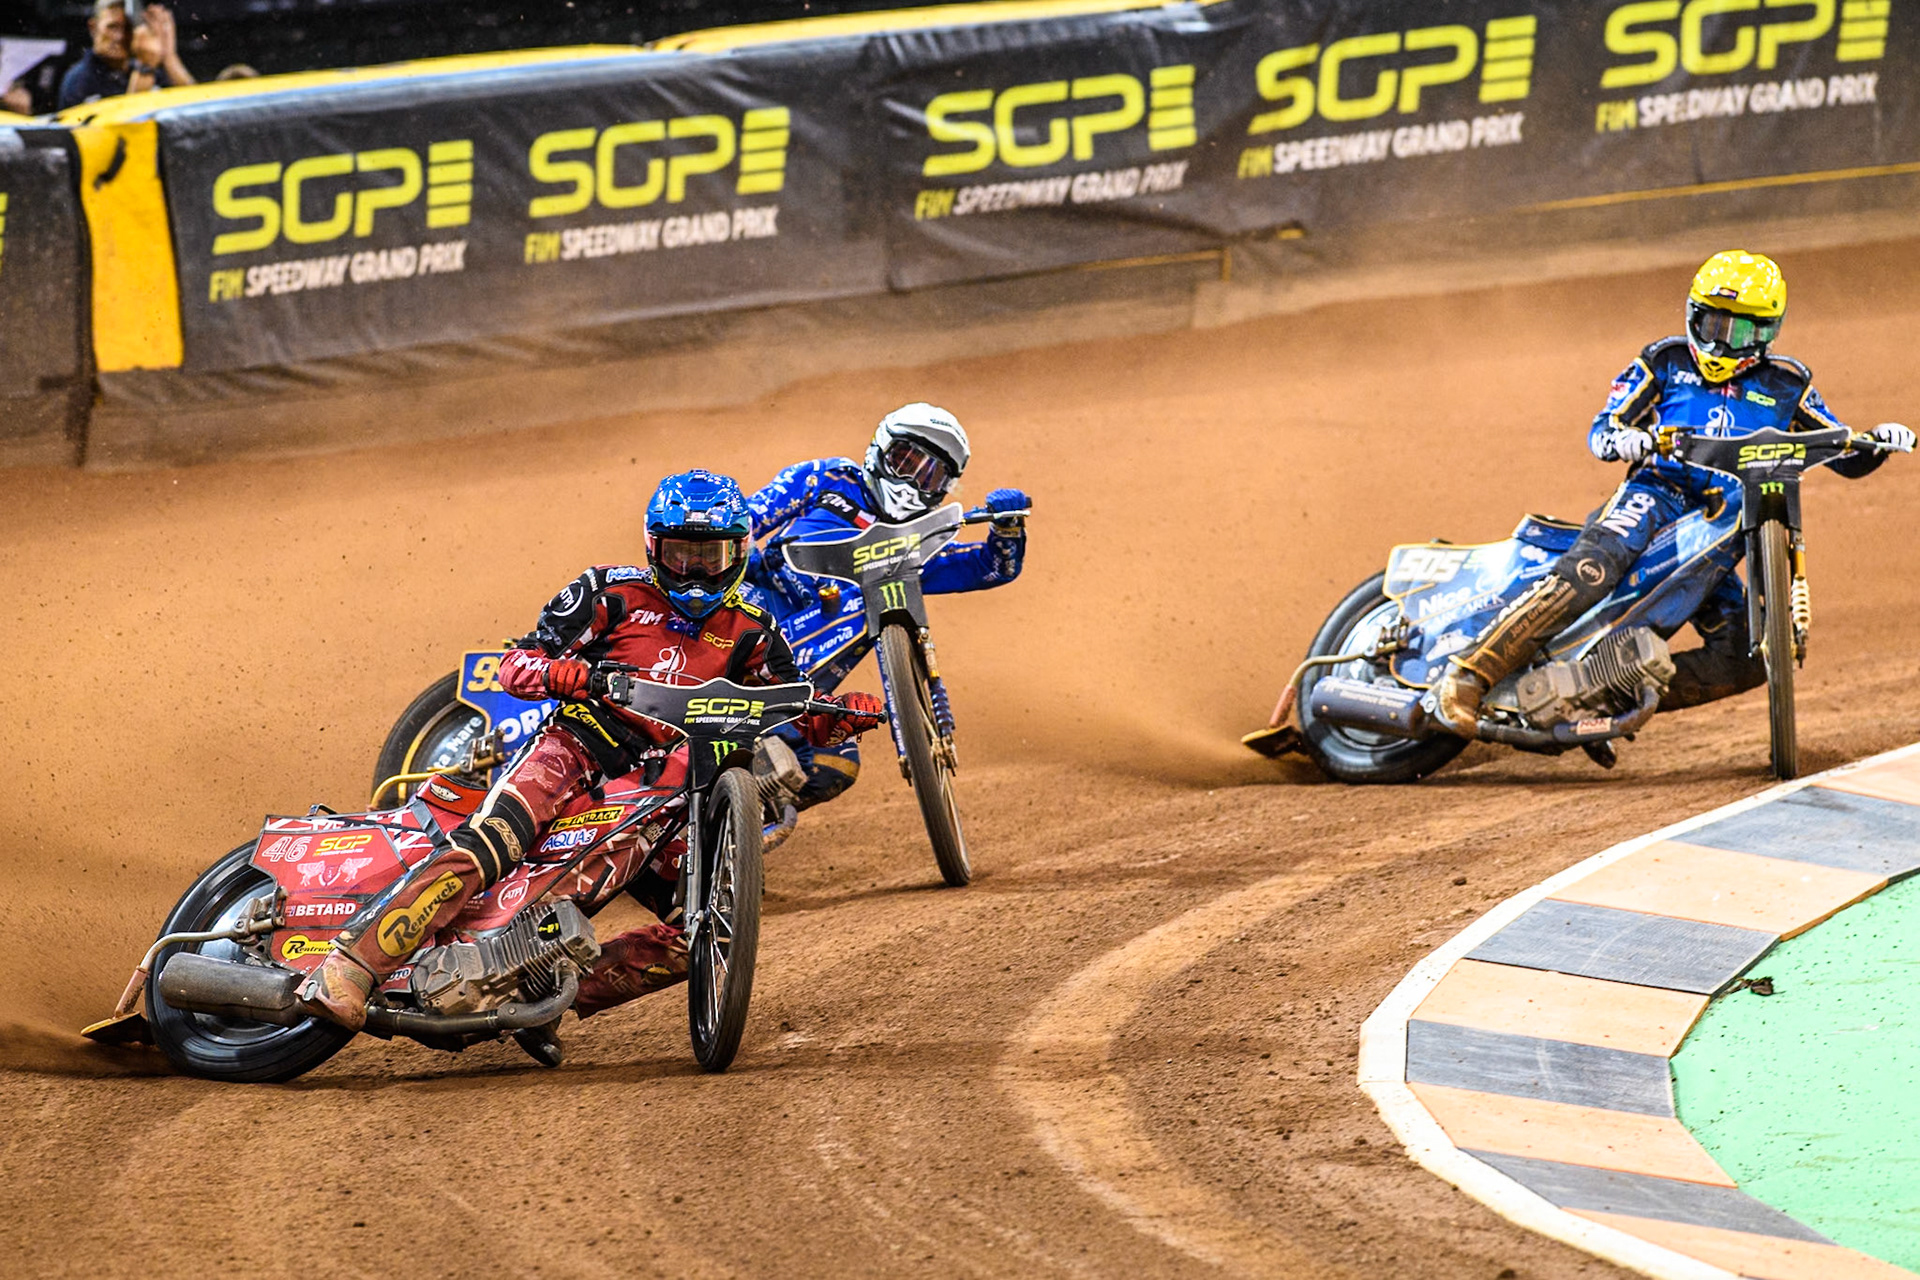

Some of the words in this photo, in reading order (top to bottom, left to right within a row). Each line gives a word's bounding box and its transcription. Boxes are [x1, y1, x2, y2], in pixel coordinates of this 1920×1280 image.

[1601, 0, 1836, 89] SGP
[1247, 24, 1478, 135] SGP
[1638, 85, 1750, 127] SPEEDWAY
[1750, 77, 1826, 114] GRAND
[1827, 72, 1878, 106] PRIX
[922, 73, 1145, 177] SGP
[1273, 130, 1392, 174] SPEEDWAY
[1392, 119, 1470, 157] GRAND
[1471, 112, 1524, 148] PRIX
[528, 114, 736, 218] SGP
[212, 148, 423, 255] SGP
[561, 219, 662, 260] SPEEDWAY
[662, 211, 730, 249] GRAND
[732, 205, 779, 240] PRIX
[244, 256, 349, 297] SPEEDWAY
[349, 246, 418, 285] GRAND
[418, 240, 467, 274] PRIX
[1738, 443, 1795, 462] SGP
[853, 536, 908, 566] SGP
[630, 610, 664, 625] FIM
[793, 608, 821, 625] ORLEN
[703, 632, 735, 649] SGP
[685, 698, 750, 716] SGP
[448, 716, 484, 752] Mare
[262, 836, 313, 862] 46
[315, 835, 373, 853] SGP
[295, 903, 356, 916] BETARD
[383, 880, 458, 949] Rentruck
